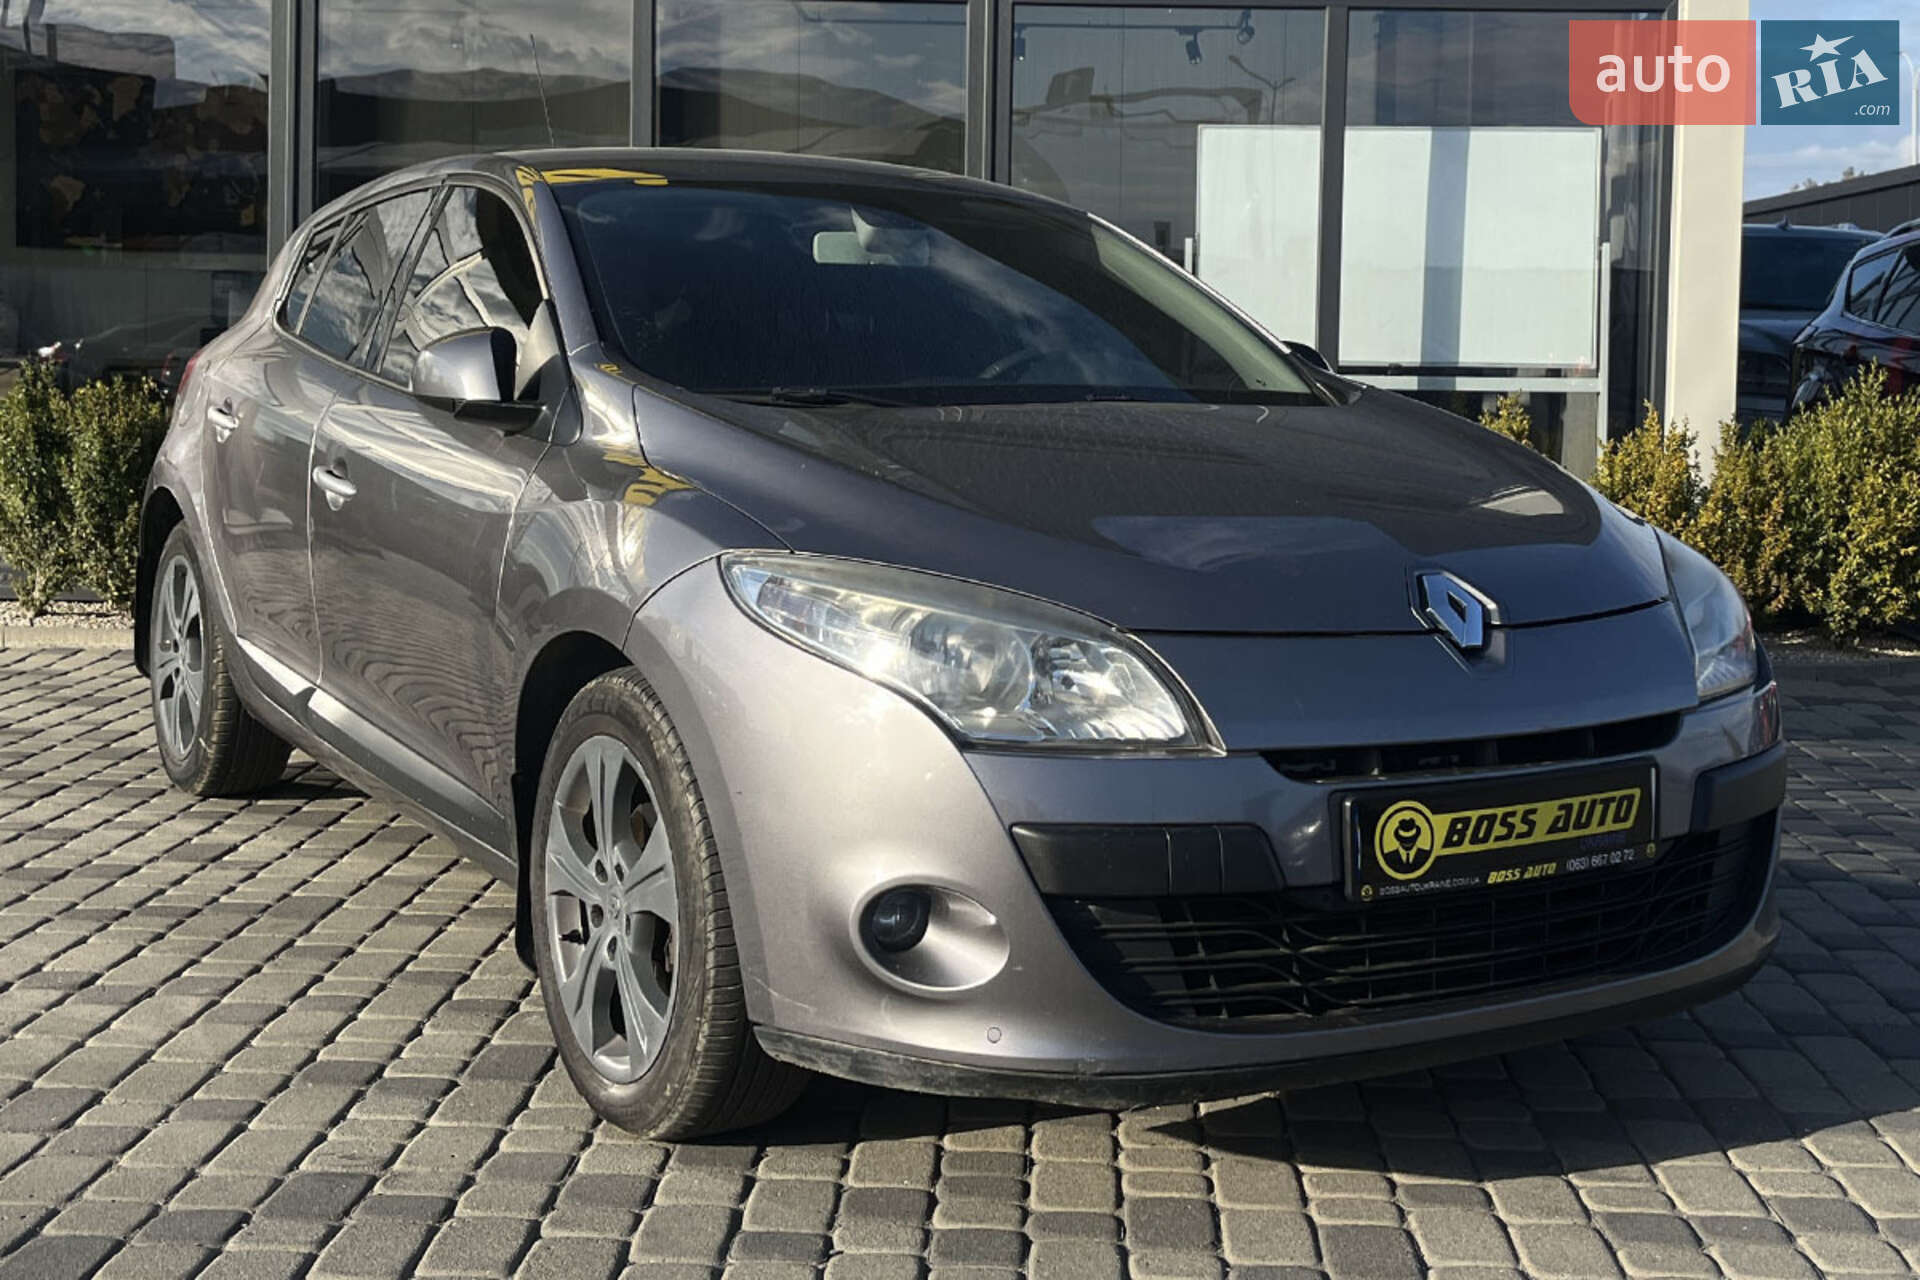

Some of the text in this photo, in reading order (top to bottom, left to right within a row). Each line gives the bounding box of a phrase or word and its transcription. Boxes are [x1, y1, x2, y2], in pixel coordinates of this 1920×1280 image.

[1441, 794, 1636, 849] BOSS AUTO
[1487, 868, 1521, 884] BOSS
[1523, 862, 1557, 879] AUTO
